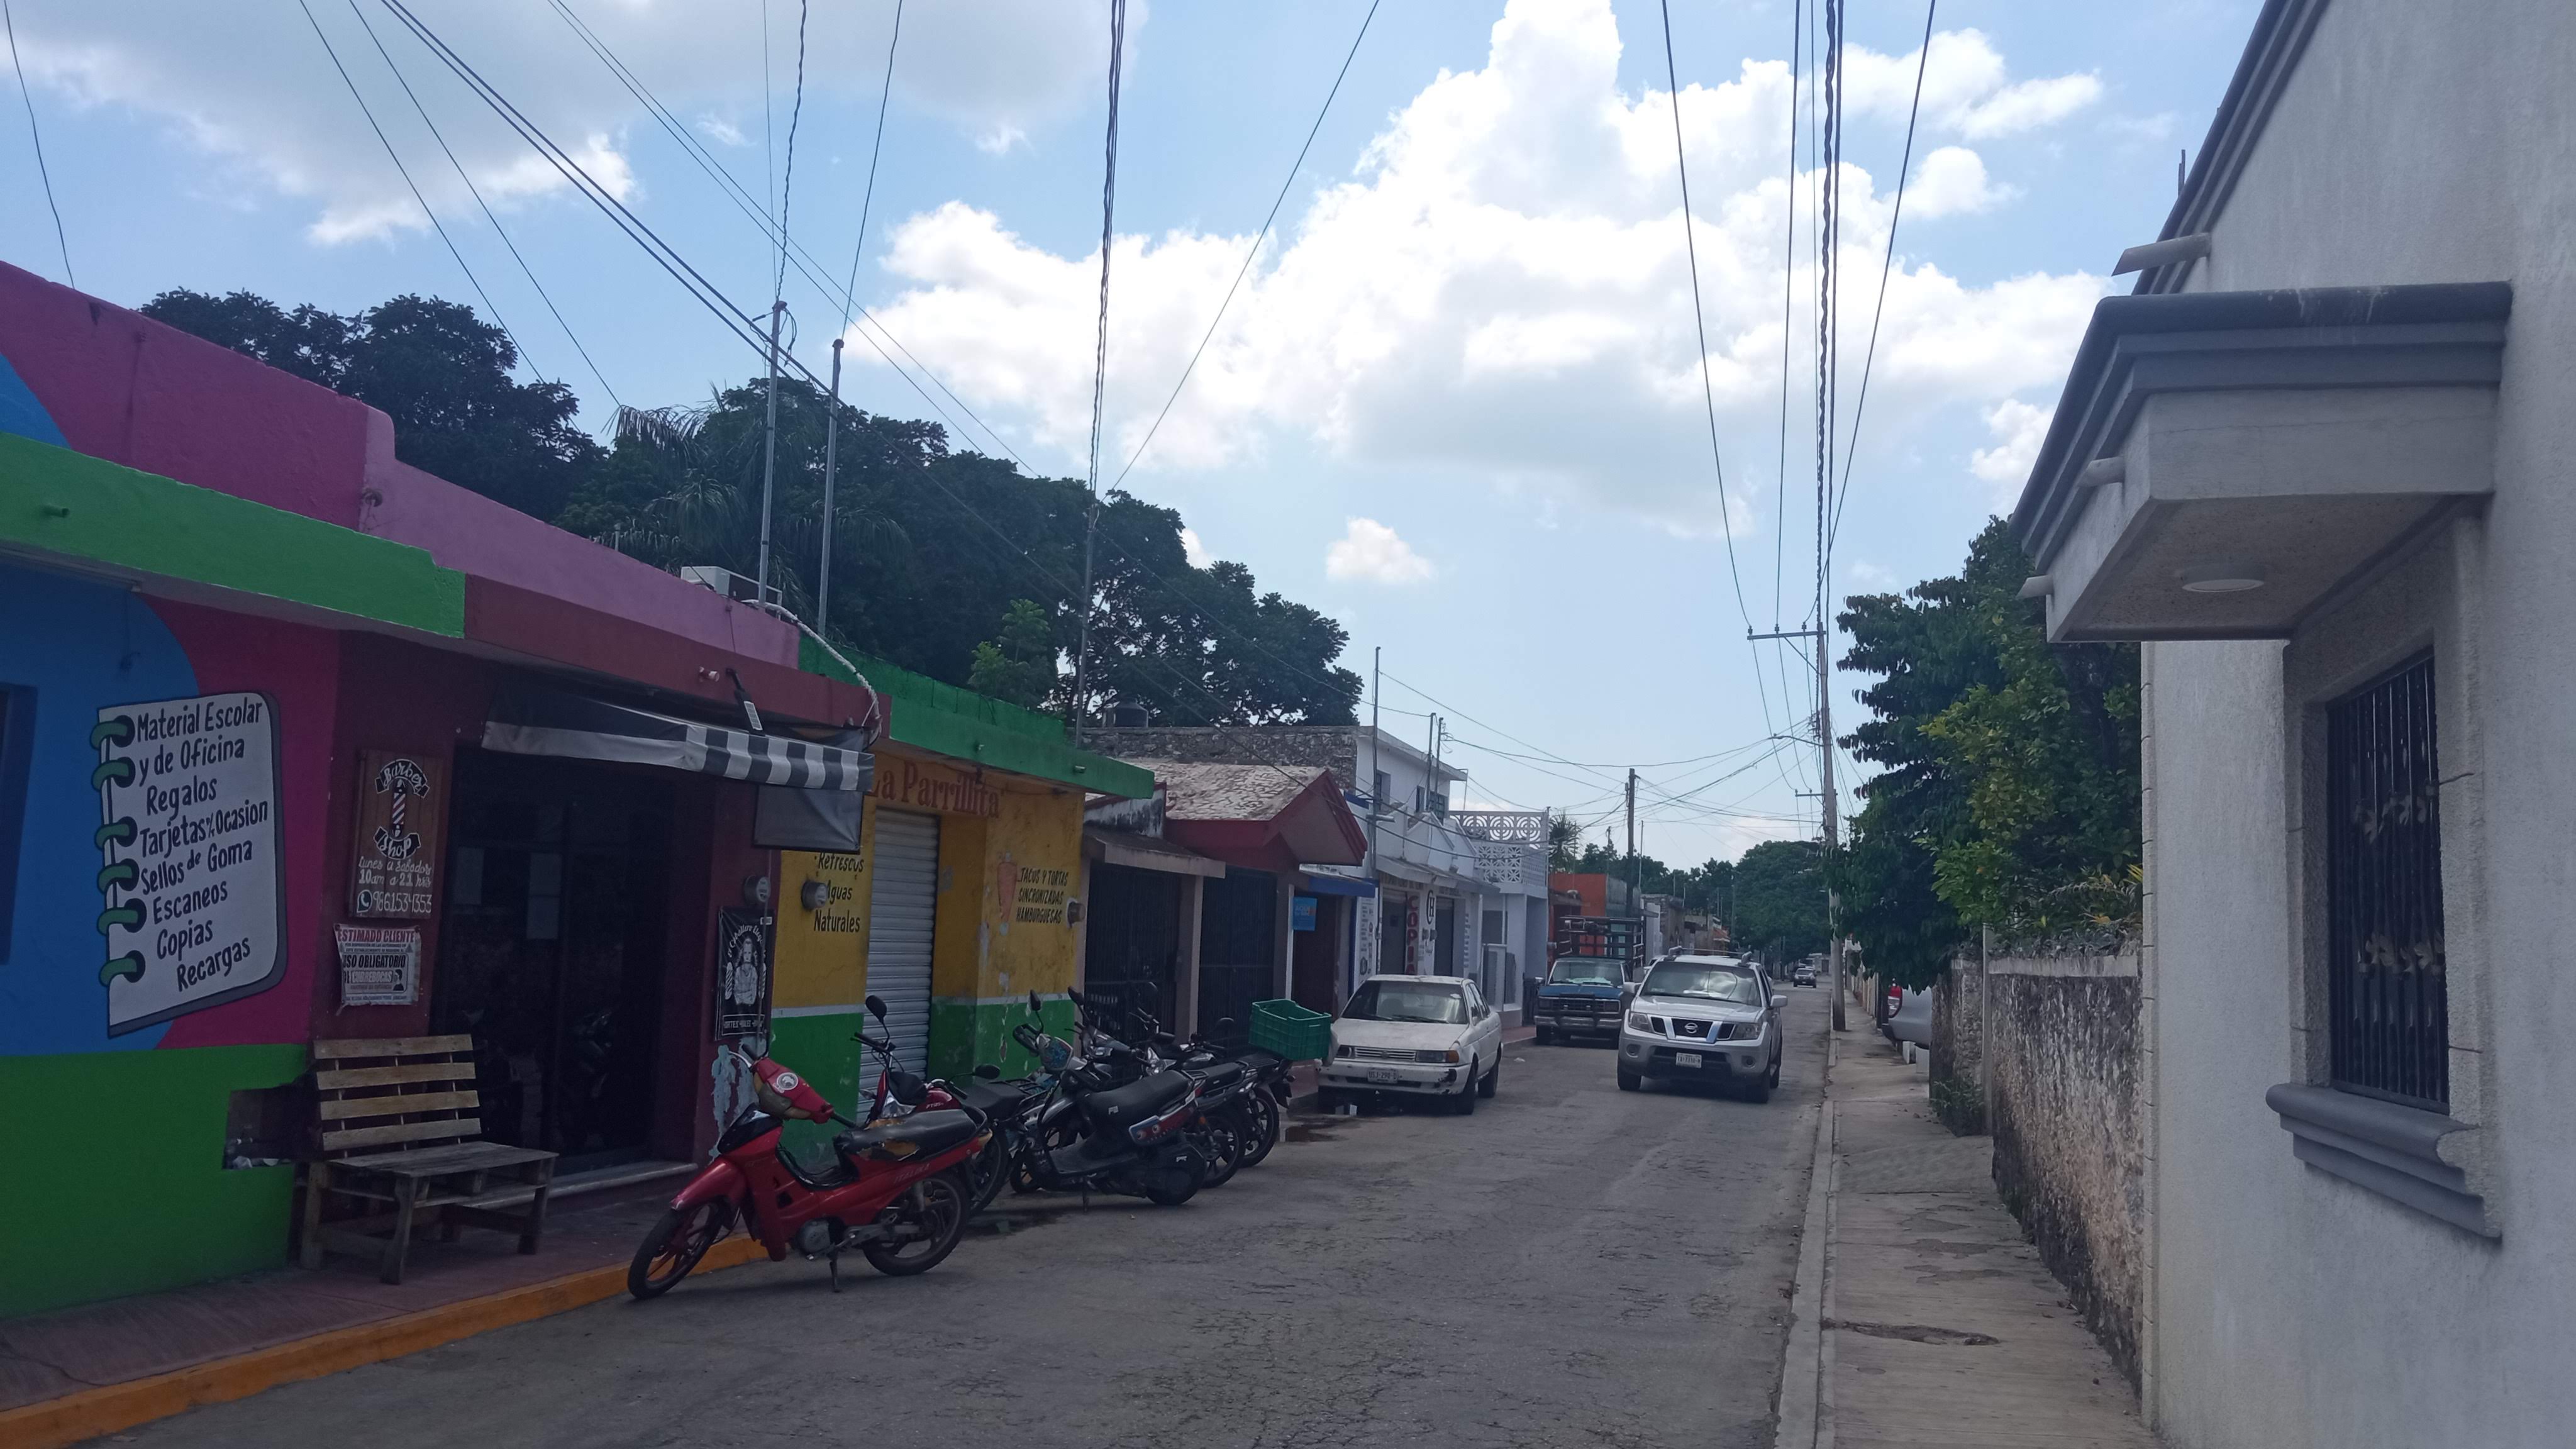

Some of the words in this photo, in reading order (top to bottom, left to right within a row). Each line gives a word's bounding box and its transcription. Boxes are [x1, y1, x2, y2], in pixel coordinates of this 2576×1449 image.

[137, 704, 199, 743] Material
[205, 697, 263, 732] Escolar
[139, 757, 149, 787] y
[154, 745, 174, 775] de
[180, 735, 245, 770] Oficina
[384, 762, 423, 793] Barber
[901, 758, 999, 819] Parrillita
[147, 775, 218, 821] Regalos
[140, 815, 206, 858] Tarjetas
[216, 799, 268, 835] Ocasion
[379, 836, 411, 859] Shop
[818, 852, 864, 872] Refrescos
[140, 860, 184, 895] Sellos
[187, 849, 201, 870] de
[208, 840, 253, 872] Goma
[358, 869, 384, 884] 10am
[390, 876, 398, 886] a
[399, 872, 413, 886] 21
[1021, 867, 1041, 884] TACOS
[1042, 870, 1047, 884] Y
[1048, 870, 1069, 886] TORTAS
[153, 881, 228, 924] Escaneos
[1018, 887, 1064, 905] SINCRONIZADAS
[814, 908, 860, 933] Naturales
[1016, 906, 1062, 924] HAMBURGUESAS
[157, 920, 213, 961] Copias
[338, 929, 382, 943] ESTIMADO
[384, 930, 415, 943] CLIENTE
[177, 937, 250, 992] Recargas
[358, 955, 406, 968] OBLIGATORIO
